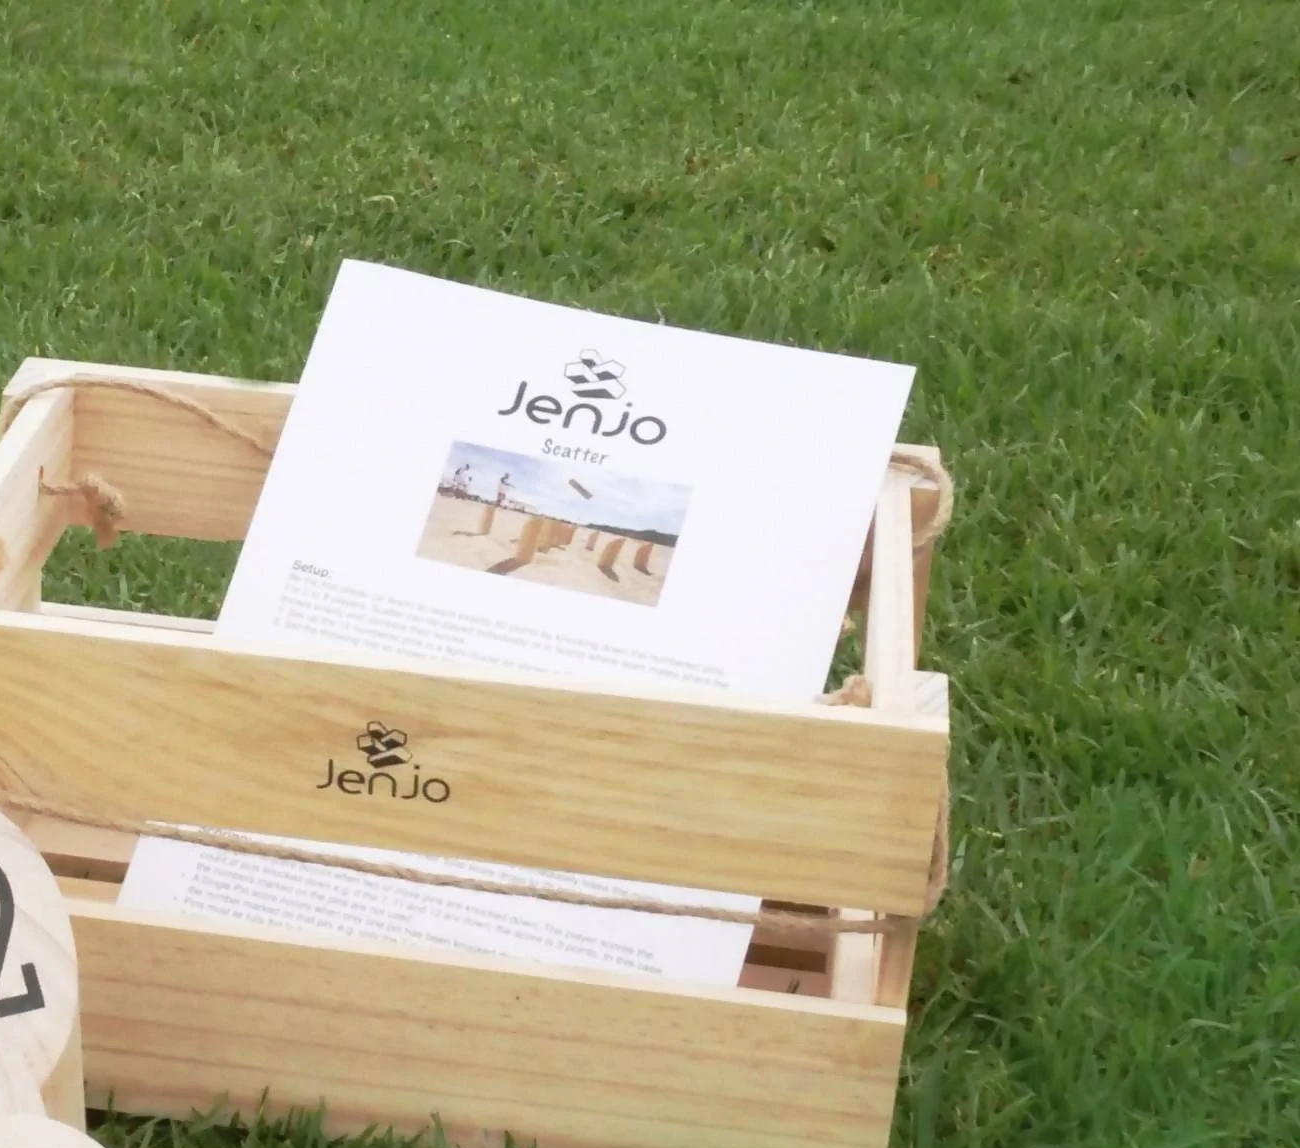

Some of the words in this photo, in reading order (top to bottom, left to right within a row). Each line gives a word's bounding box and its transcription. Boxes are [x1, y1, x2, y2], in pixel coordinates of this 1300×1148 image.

[498, 380, 667, 445] Jenjo
[542, 438, 610, 465] Scatter
[316, 759, 451, 803] Jenjo
